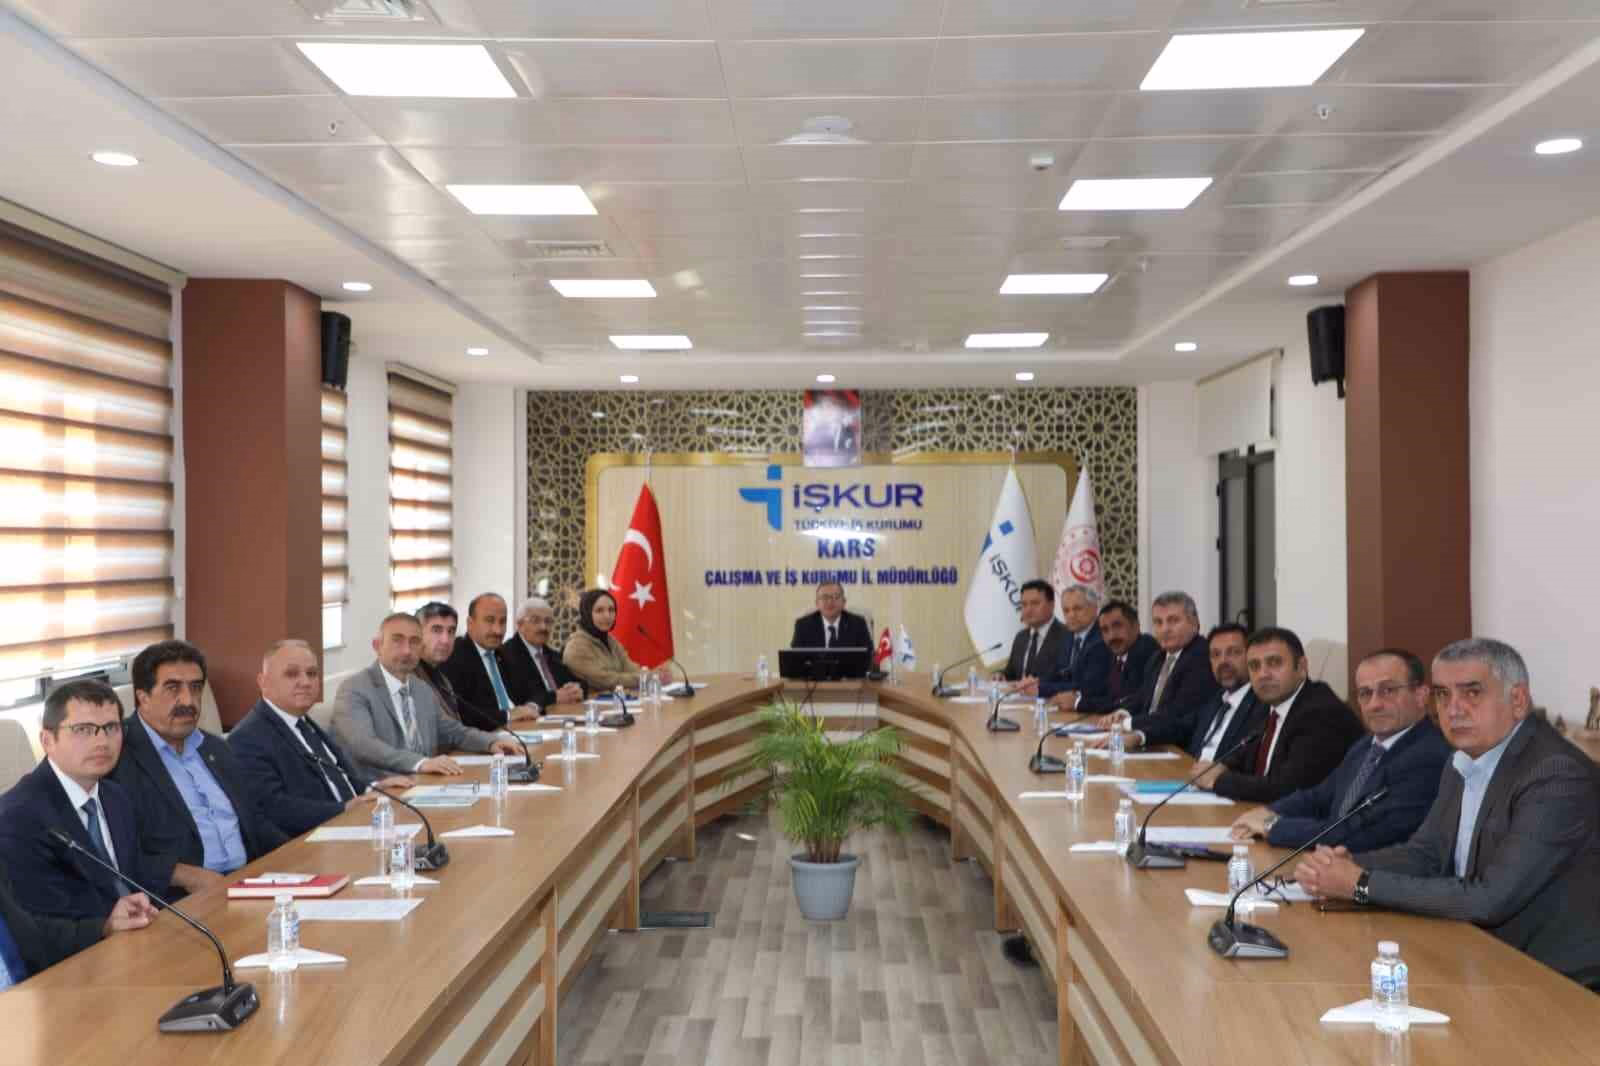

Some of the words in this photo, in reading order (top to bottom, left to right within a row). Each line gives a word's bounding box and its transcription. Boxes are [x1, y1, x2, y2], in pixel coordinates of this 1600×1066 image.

[866, 519, 923, 530] KURUMU
[817, 538, 876, 558] KARS
[705, 569, 762, 587] ÇALIŞMA
[766, 569, 781, 585] VE
[785, 565, 798, 586] İŞ
[862, 565, 873, 585] İL
[877, 565, 958, 585] MÜDÜRLÜĞÜ
[990, 553, 1022, 611] İŞKU
